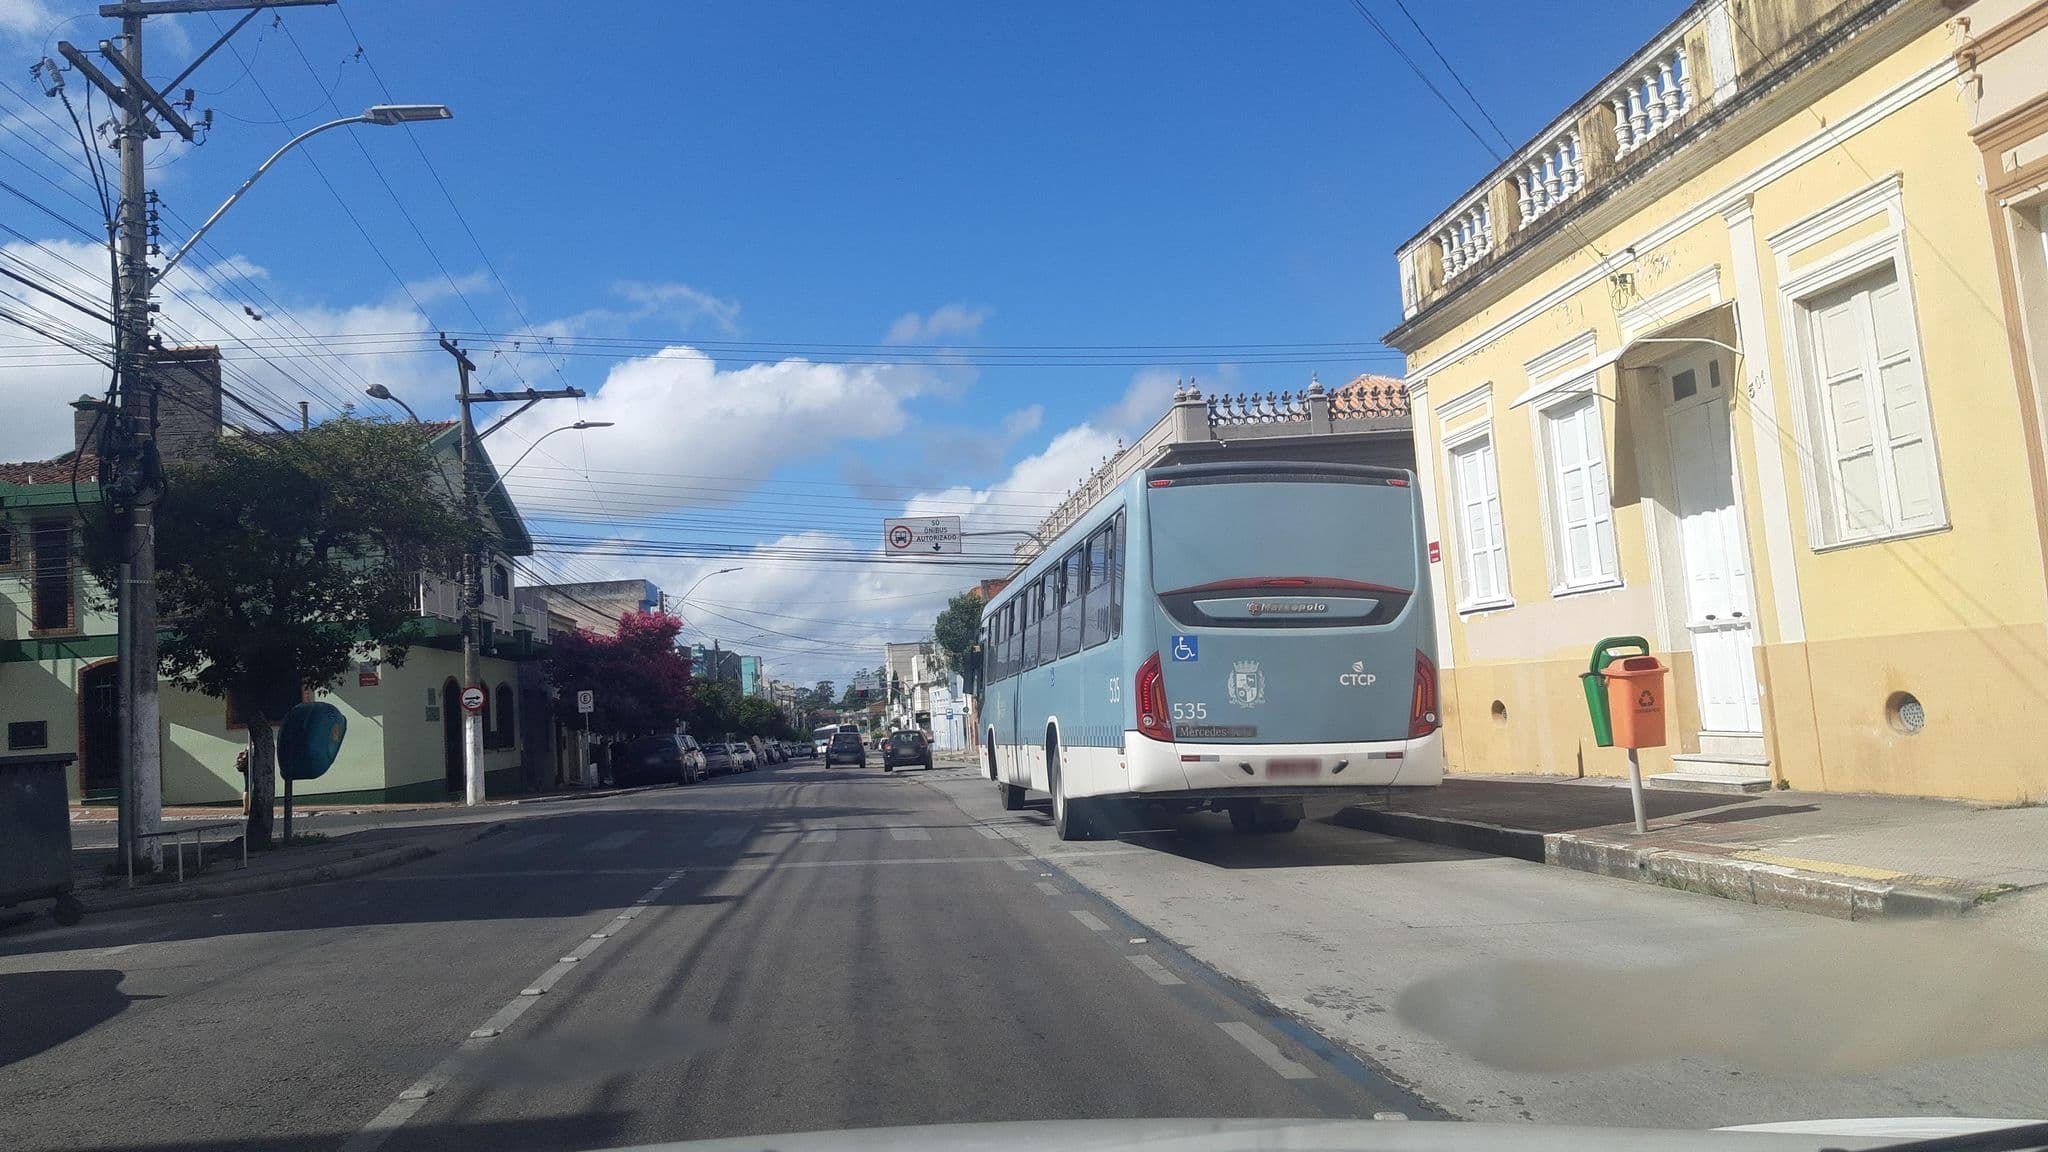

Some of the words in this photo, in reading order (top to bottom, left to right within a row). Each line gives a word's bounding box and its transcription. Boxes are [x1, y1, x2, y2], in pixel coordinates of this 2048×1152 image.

[916, 534, 957, 542] AUTORIZADO
[1340, 673, 1376, 686] CTCP
[1109, 677, 1121, 703] 535
[1173, 702, 1207, 720] 535
[1180, 727, 1253, 737] Mercedes-
